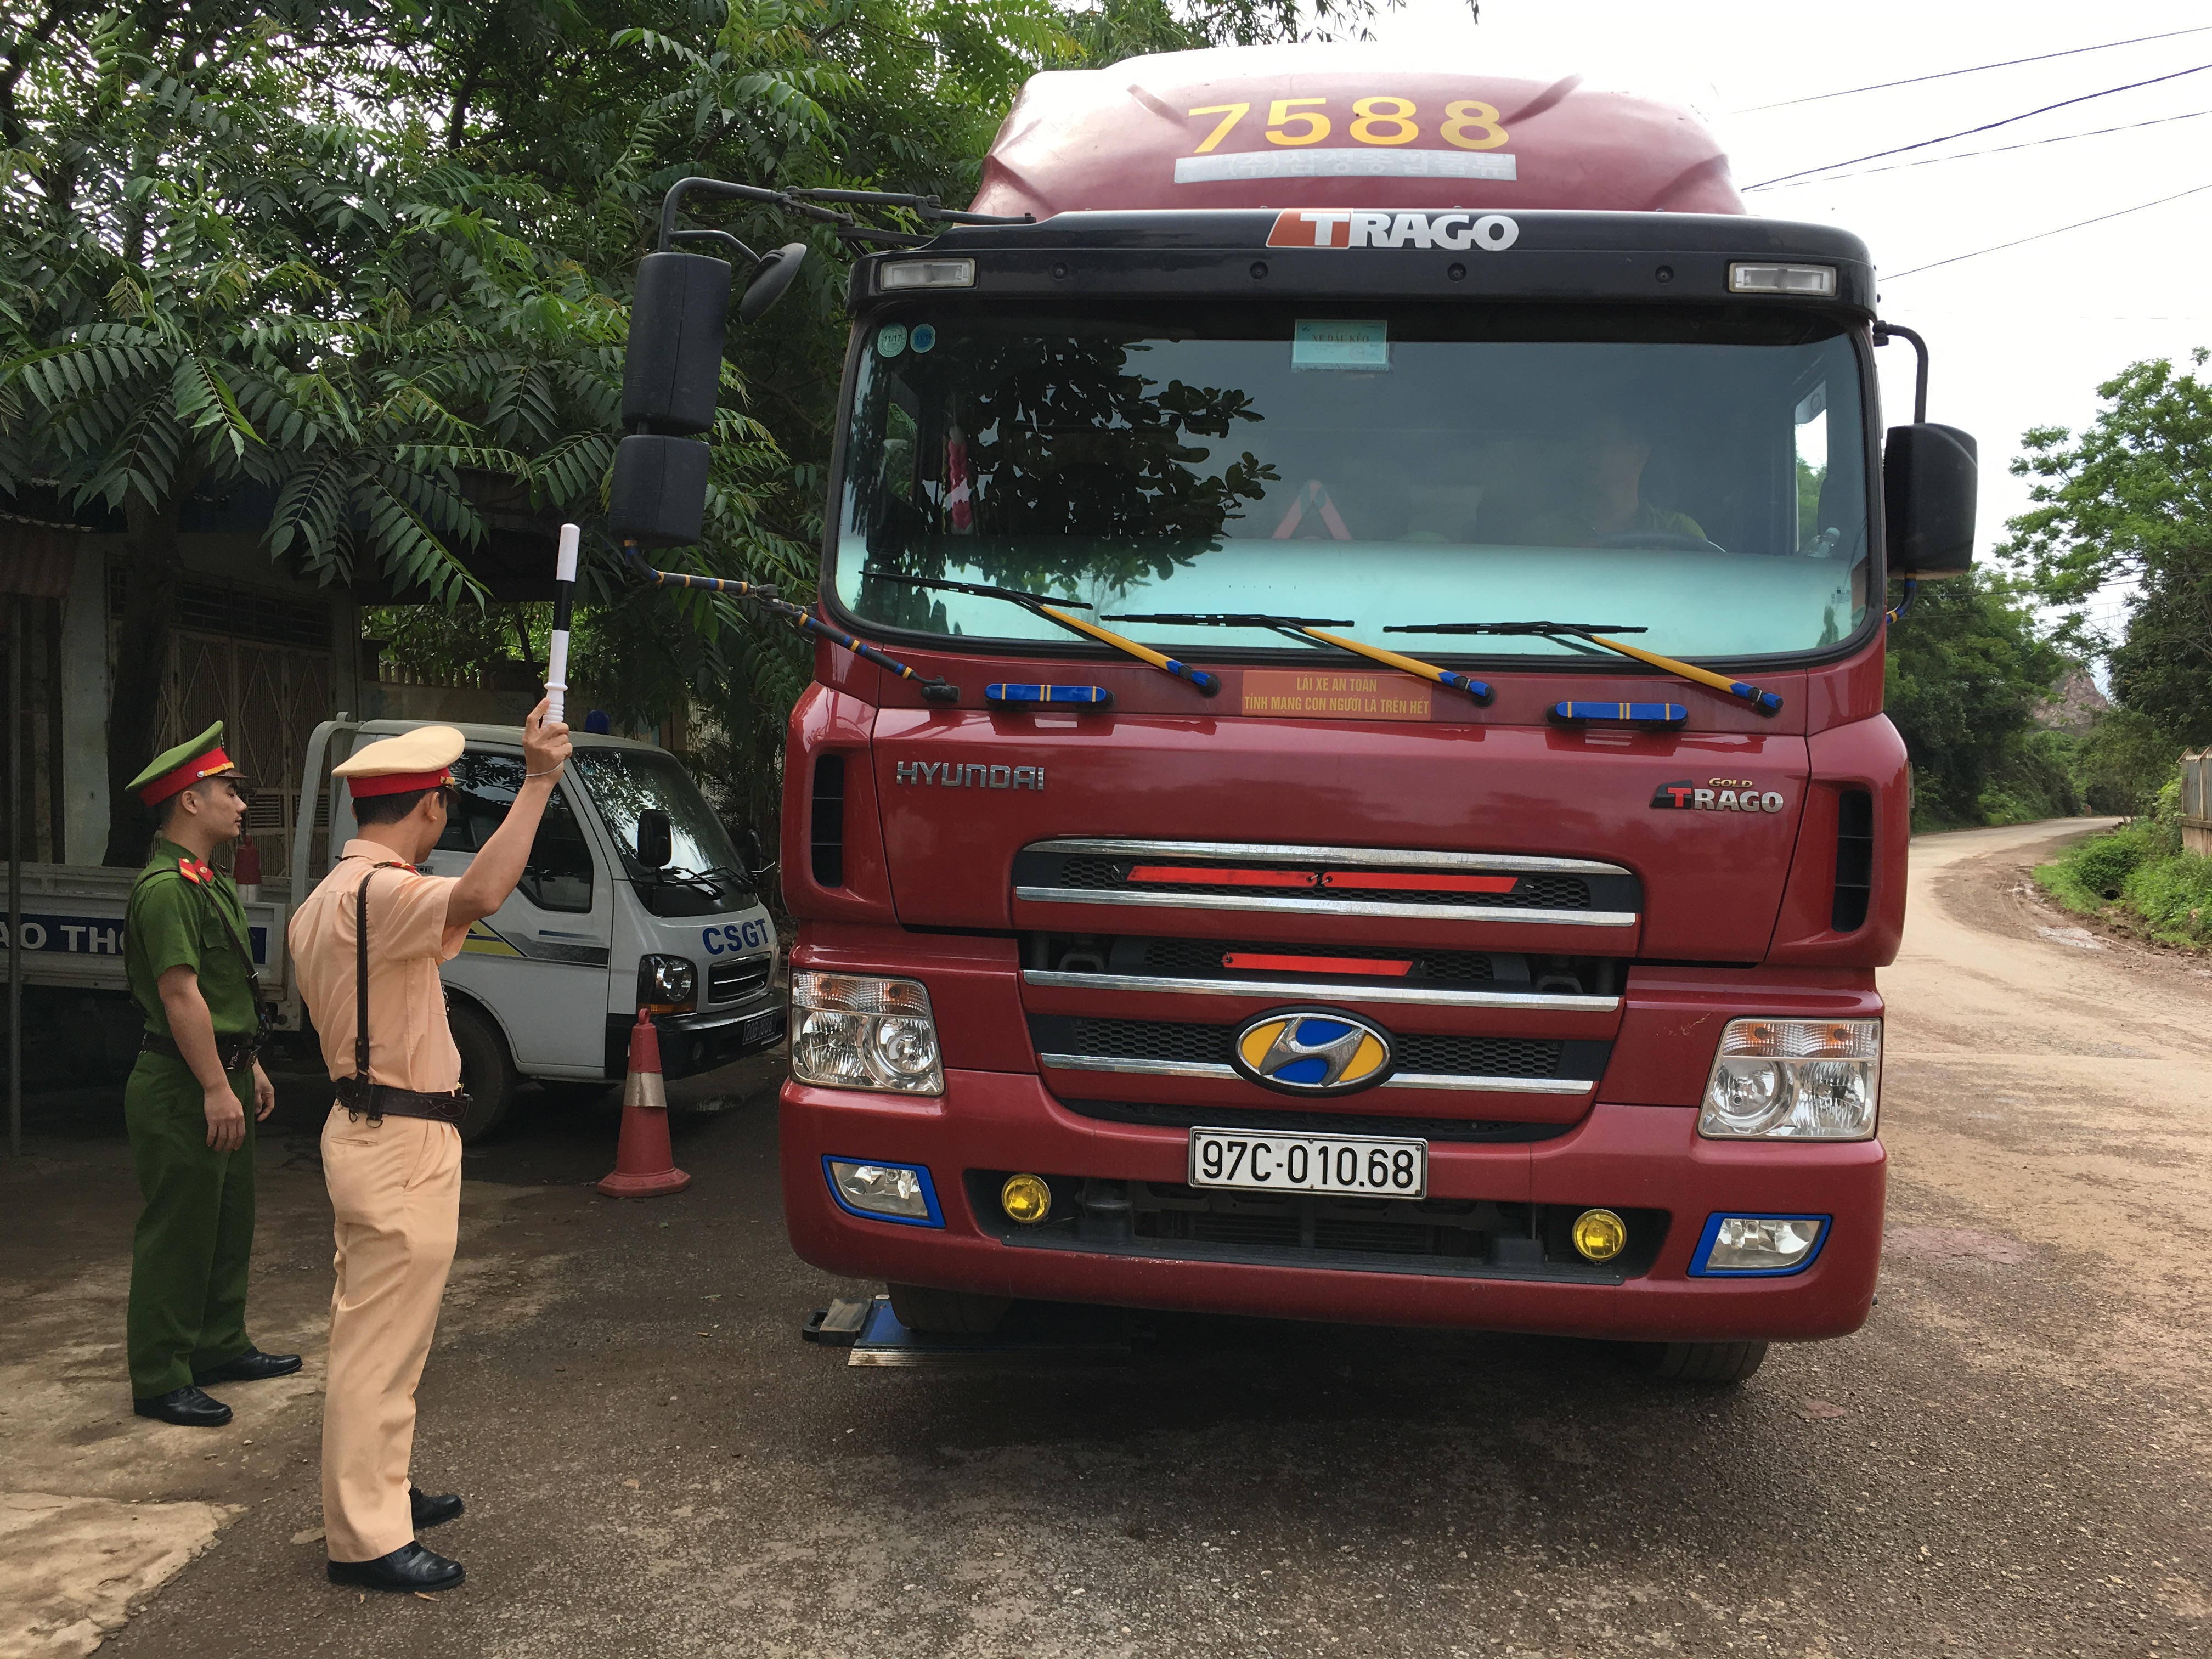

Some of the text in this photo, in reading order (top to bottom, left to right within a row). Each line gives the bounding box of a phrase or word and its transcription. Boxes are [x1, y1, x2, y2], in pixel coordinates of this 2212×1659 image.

[1188, 96, 1510, 153] 7588
[1300, 212, 1519, 251] TRAGO
[884, 334, 902, 342] 11/17
[1296, 674, 1377, 692] LÁI XE AN TOÀN
[1244, 693, 1429, 714] TÍNH MẠNG CON NGƯỜI LÀ TRÊN HẾT
[896, 761, 1045, 790] HYUNDAI
[1708, 777, 1753, 788] GOLD
[1667, 787, 1784, 813] TRAGO
[60, 925, 124, 954] TH
[702, 918, 769, 955] CSGT
[1202, 1139, 1414, 1189] 97C-010.68
